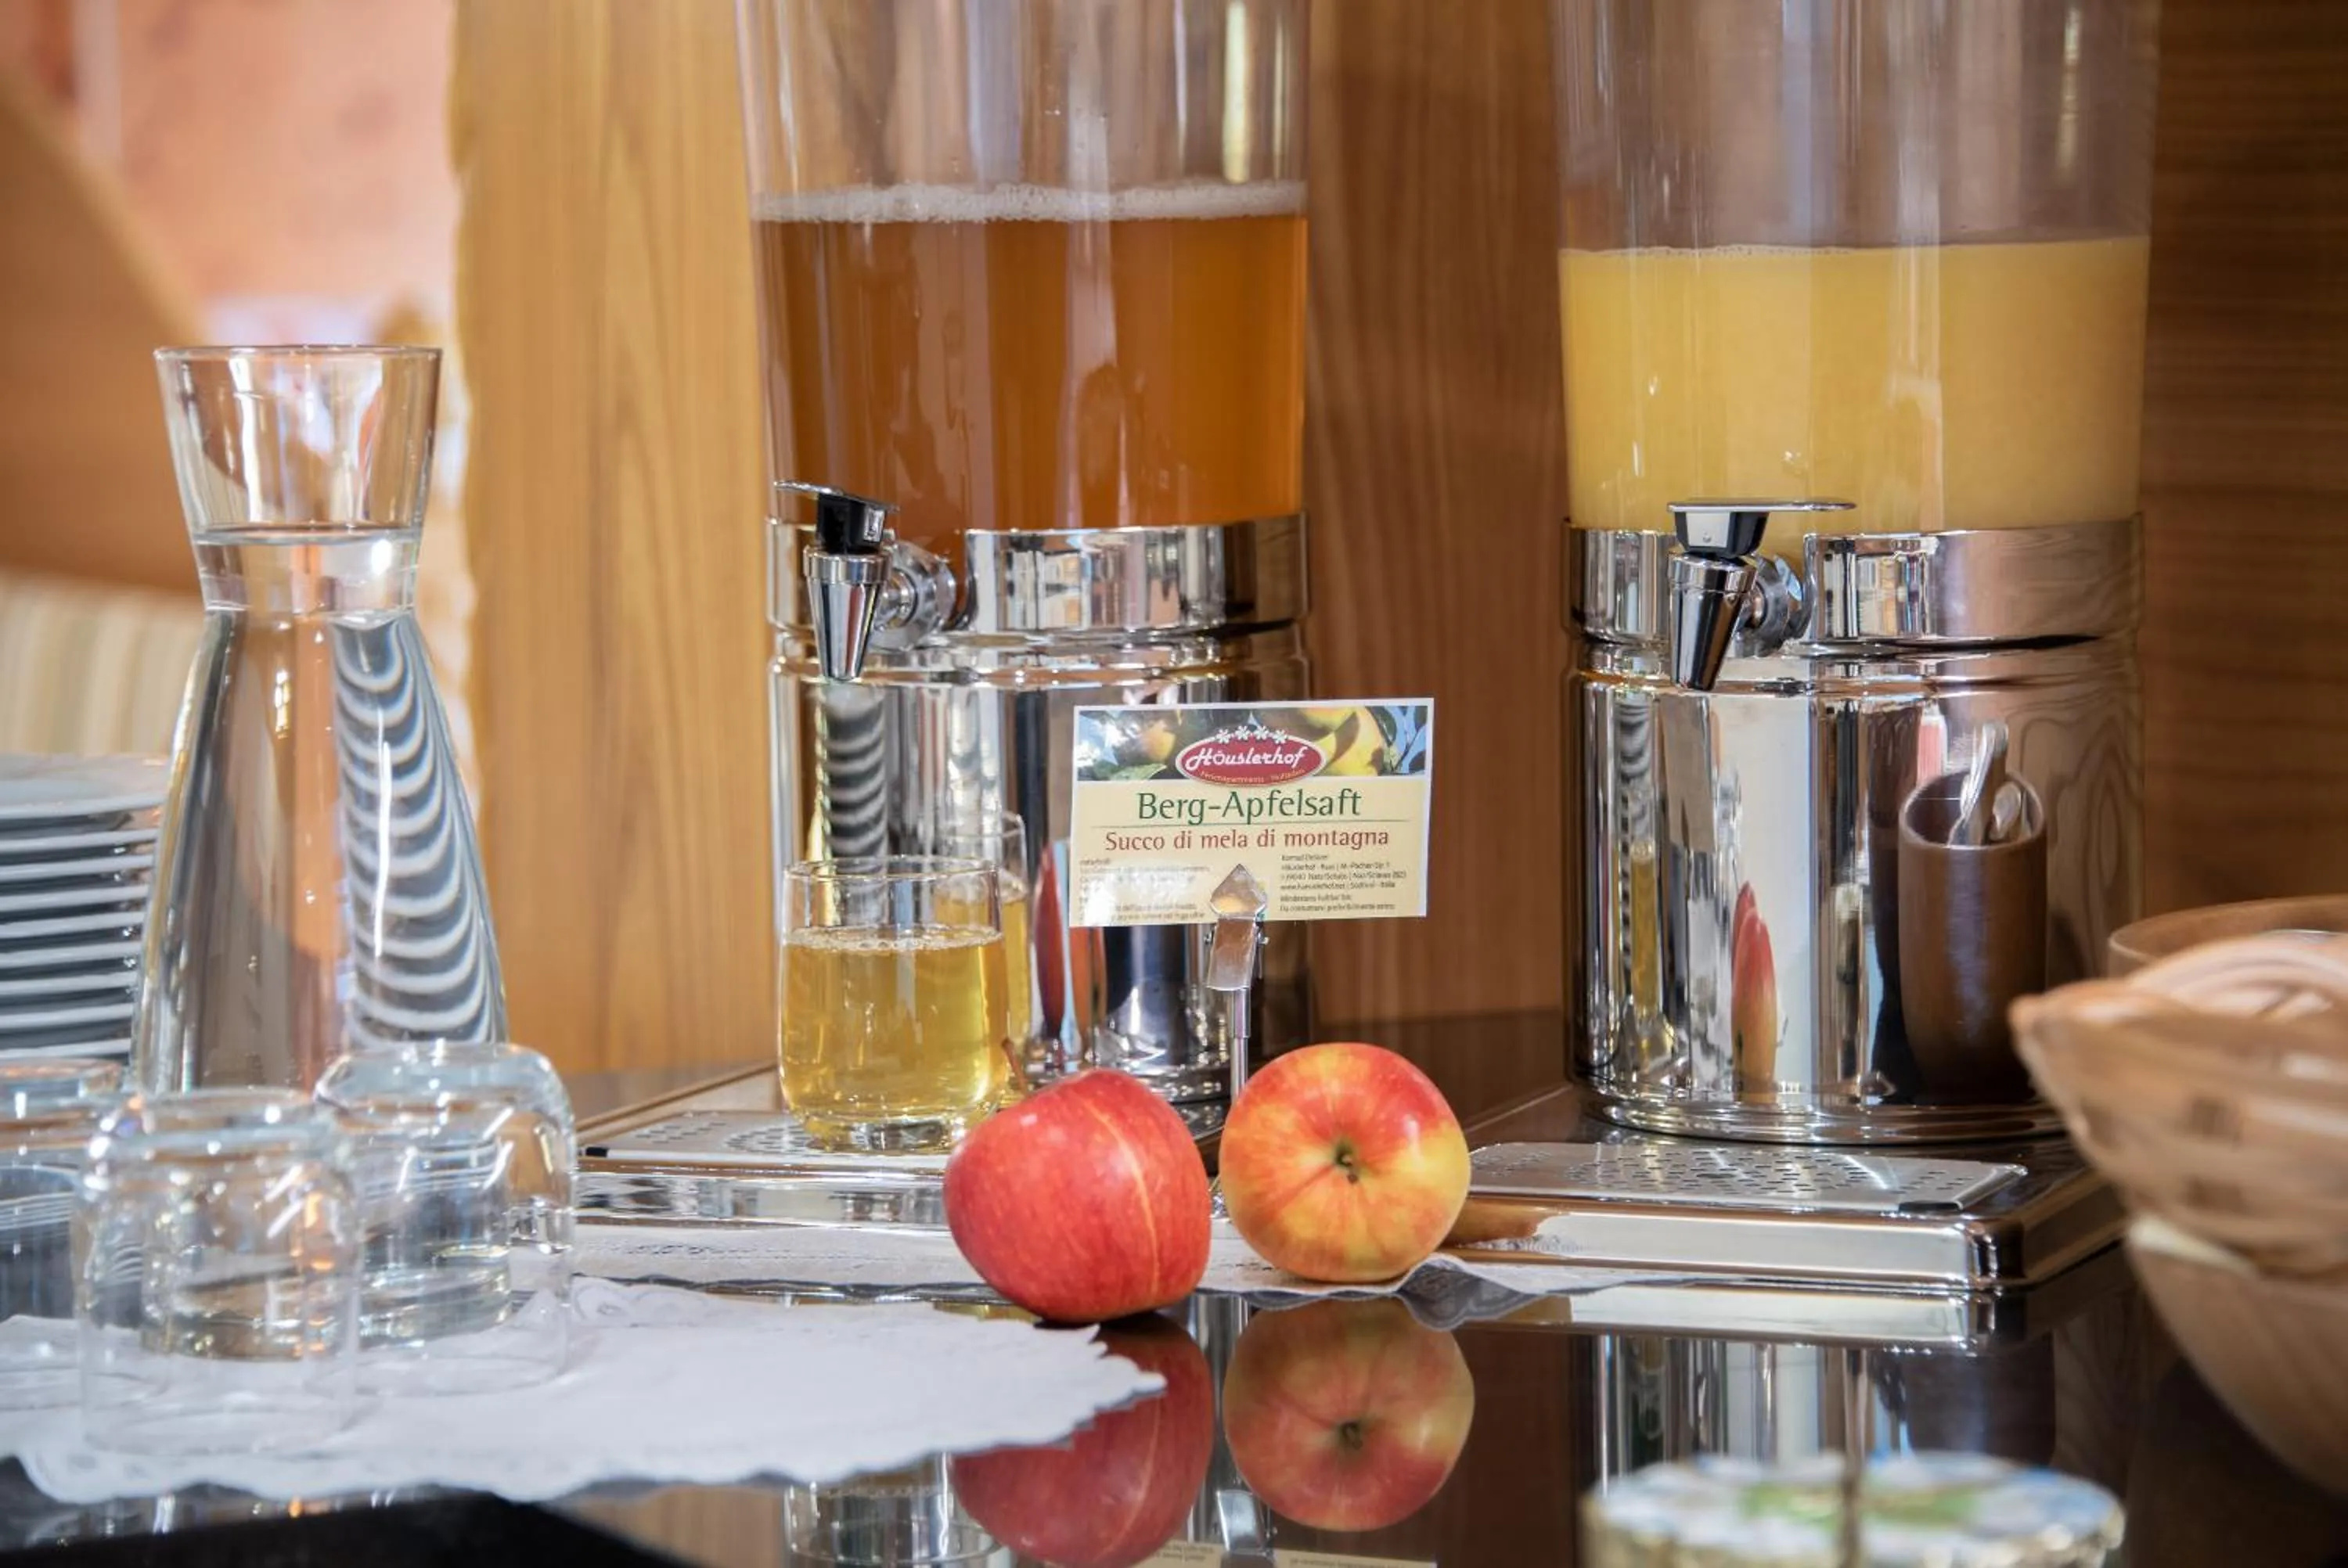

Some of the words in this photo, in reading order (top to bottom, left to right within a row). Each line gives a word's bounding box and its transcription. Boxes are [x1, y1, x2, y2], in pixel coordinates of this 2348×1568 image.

[1137, 788, 1362, 825] Berg-Apfelsaft
[1105, 832, 1165, 851] Succo
[1173, 829, 1192, 850] di
[1201, 829, 1248, 849] mela
[1257, 829, 1276, 848] di
[1284, 829, 1389, 851] montagna
